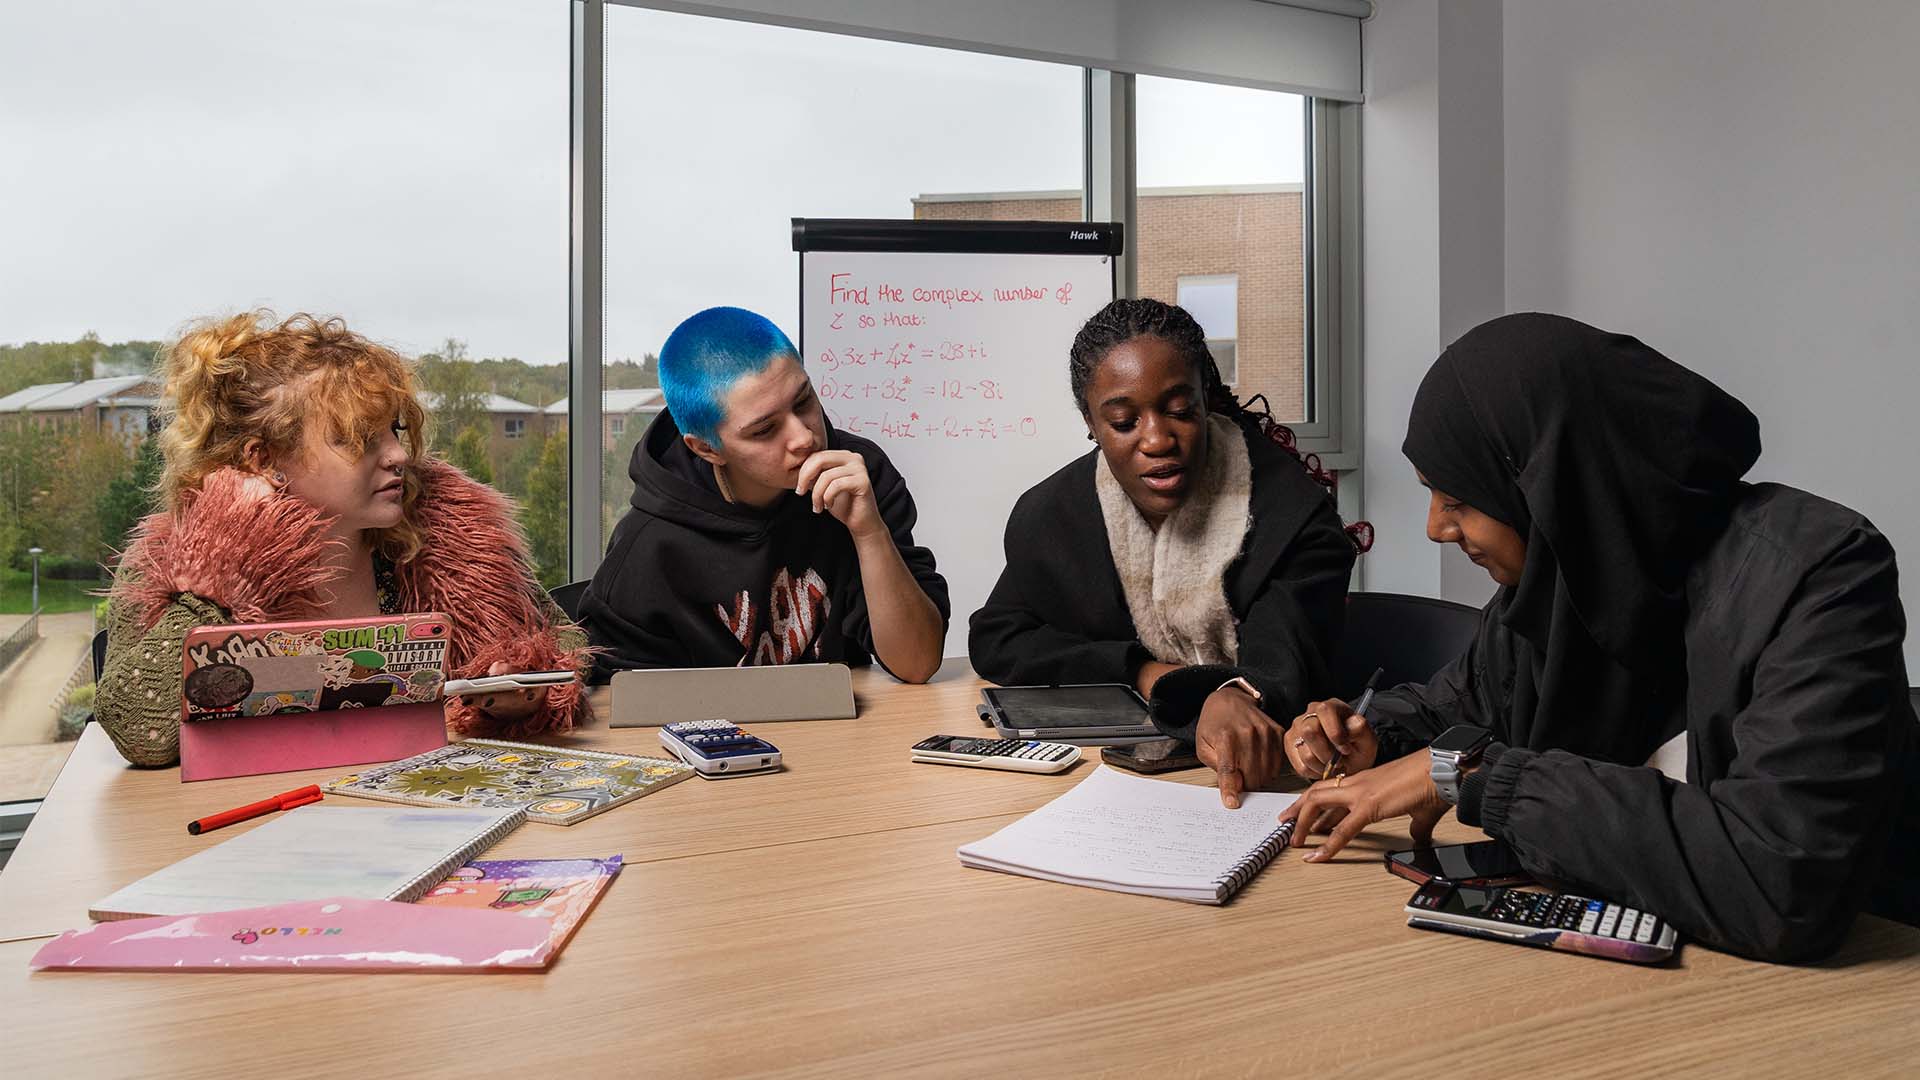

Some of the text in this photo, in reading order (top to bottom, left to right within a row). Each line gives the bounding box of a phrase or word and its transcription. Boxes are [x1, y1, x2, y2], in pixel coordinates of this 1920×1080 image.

[1070, 230, 1099, 240] Hawk
[831, 273, 869, 305] Find
[879, 284, 904, 303] the
[912, 287, 983, 310] complex
[1055, 281, 1072, 305] of
[859, 315, 876, 328] so
[883, 312, 927, 327] that:
[323, 625, 405, 650] SUM 41
[388, 650, 442, 663] DVISORY
[260, 927, 343, 936] HELLO
